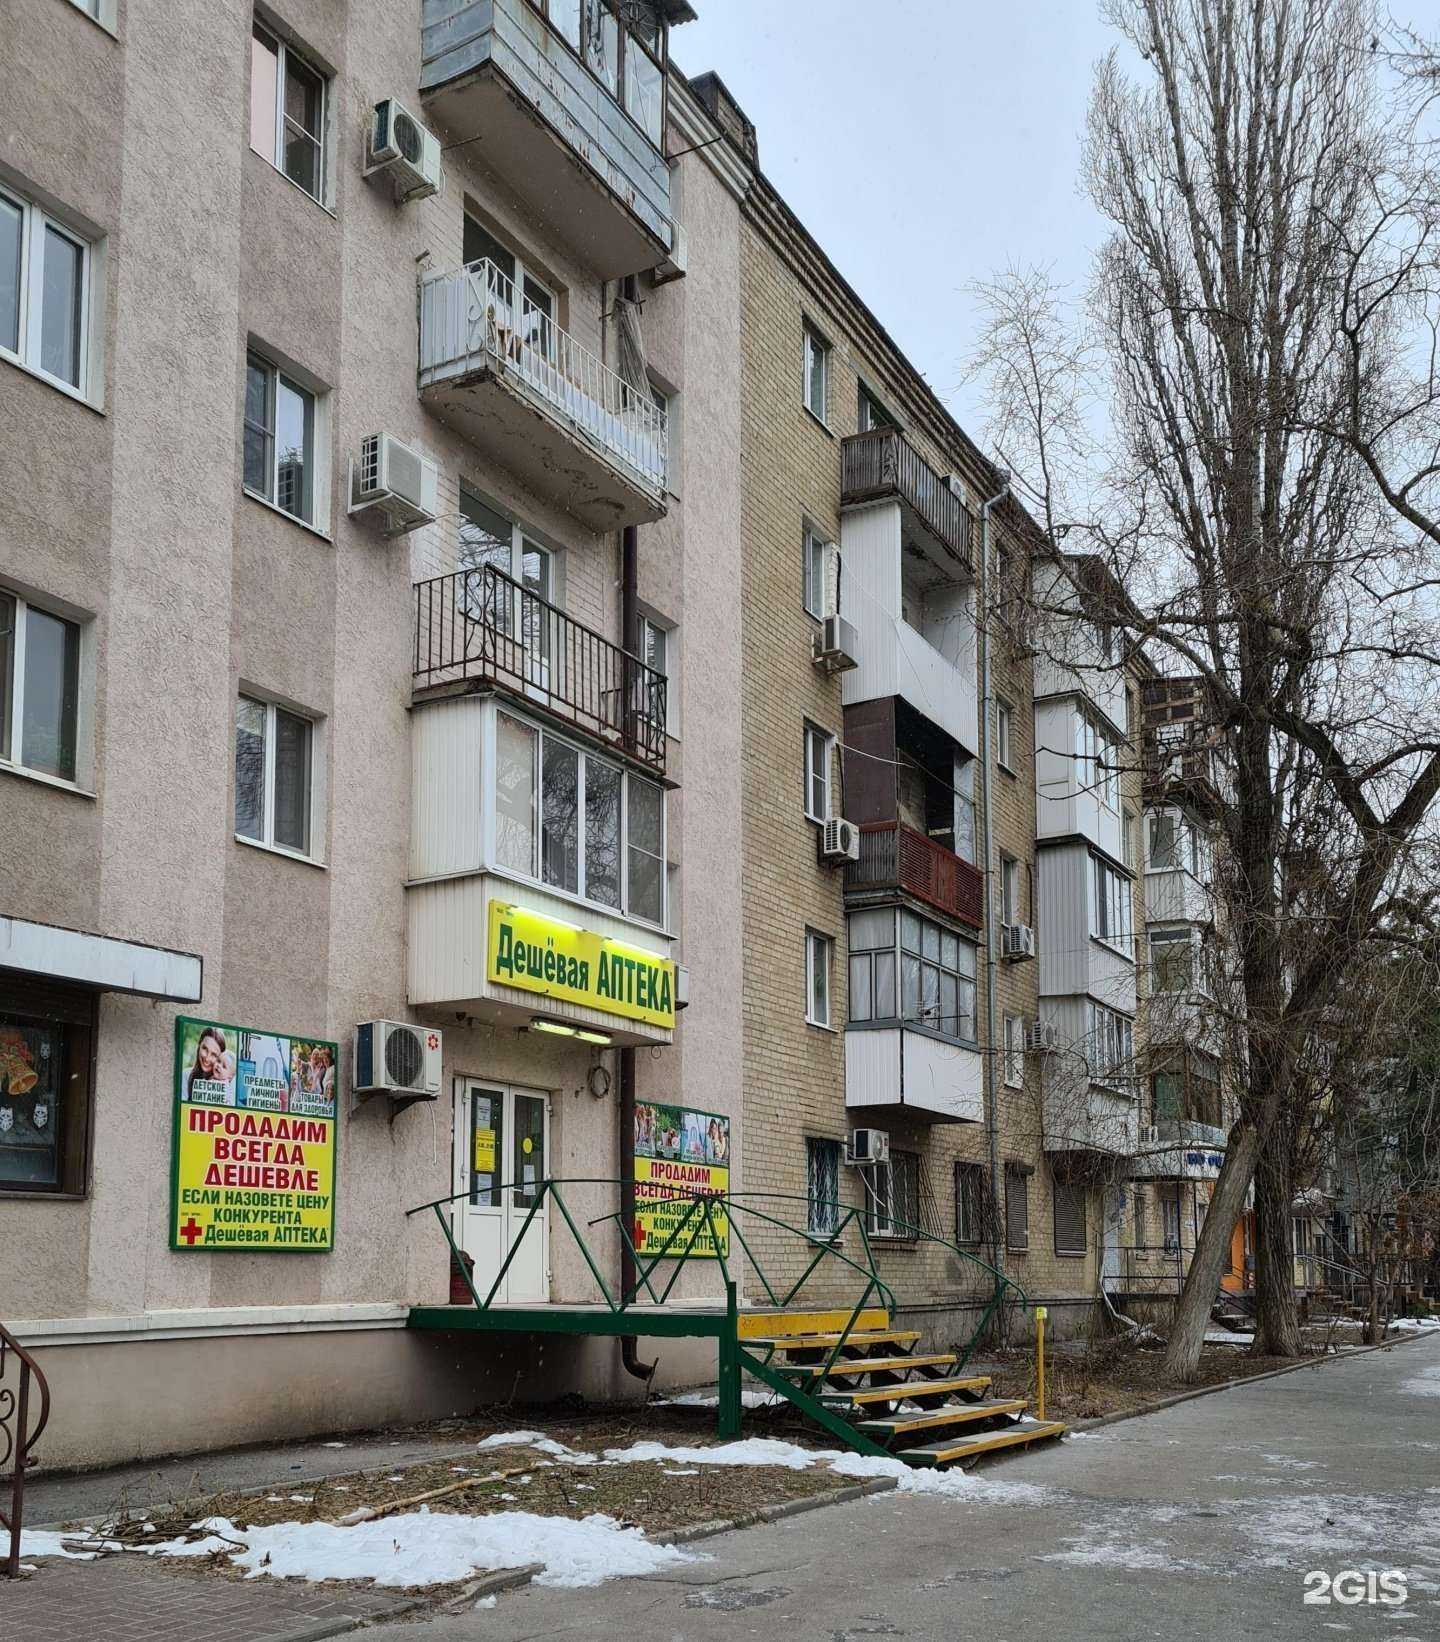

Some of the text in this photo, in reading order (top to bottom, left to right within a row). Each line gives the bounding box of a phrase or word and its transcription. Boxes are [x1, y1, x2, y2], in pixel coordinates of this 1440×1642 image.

[496, 923, 673, 1014] Дешёвая АПТЕКА
[193, 1079, 226, 1092] ДЕТСКОЕ
[244, 1075, 286, 1089] ПРЕДМЕТЫ
[248, 1098, 281, 1111] ГИГИЕНЫ
[189, 1108, 327, 1143] ПРОДАДИМ
[214, 1137, 305, 1166] ВСЕГДА
[204, 1163, 319, 1191] ДЕШЕВЛЕ
[650, 1162, 711, 1184] ПРОДАДИМ
[182, 1189, 330, 1210] ЕСЛИ НАЗОВЕТЕ ЦЕНУ
[213, 1208, 302, 1225] КОНКУРЕНТА
[204, 1224, 328, 1244] Дешёвая АПТЕКА
